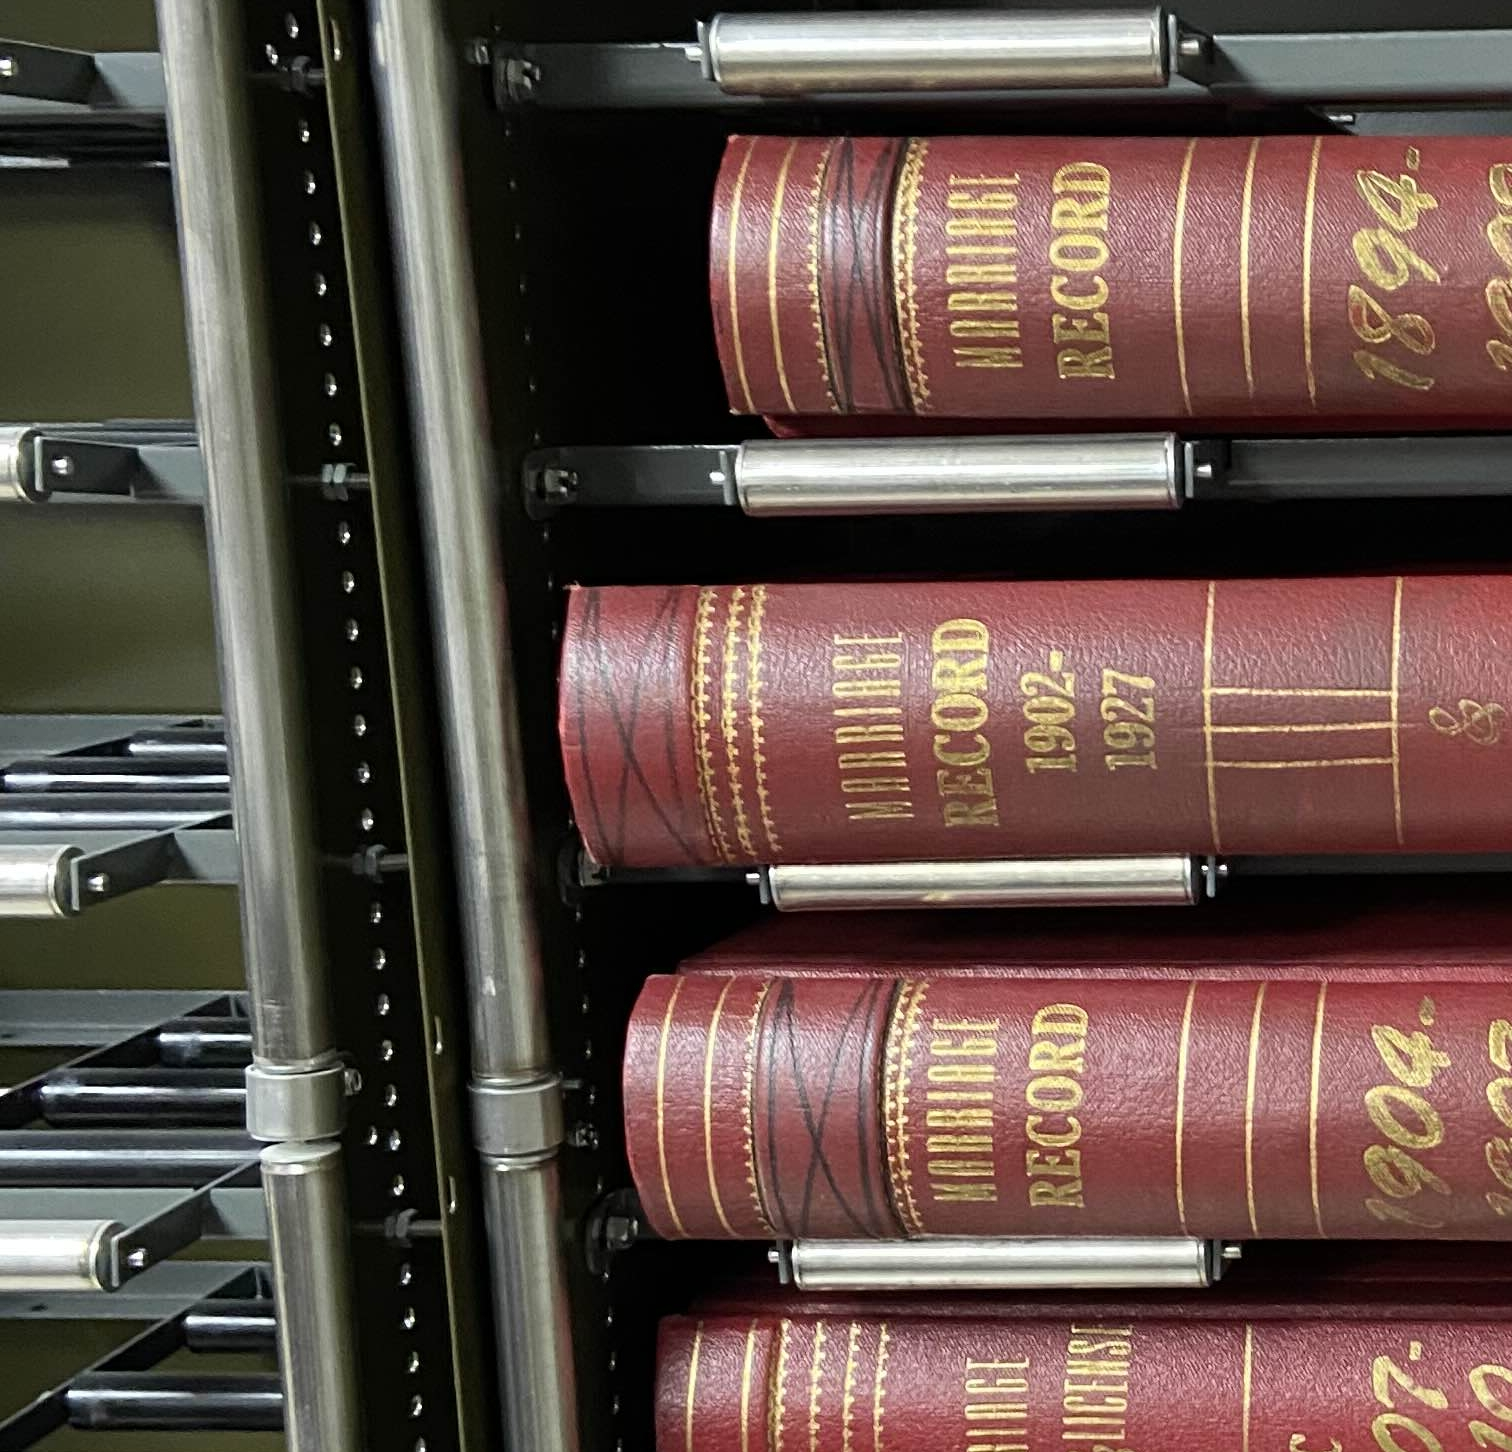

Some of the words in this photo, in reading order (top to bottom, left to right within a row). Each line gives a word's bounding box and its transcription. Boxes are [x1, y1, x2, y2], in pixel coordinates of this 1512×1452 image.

[946, 171, 1022, 369] MARRIAGE
[1049, 161, 1114, 379] RECORD
[1347, 147, 1441, 392] 1894-
[833, 631, 917, 821] MARRIAGE
[931, 617, 999, 828] RECORD
[1020, 651, 1079, 774] 1902-
[1100, 669, 1158, 772] 1927
[924, 1017, 1002, 1203] MARRIAGE
[1029, 1002, 1090, 1210] RECORD
[1062, 1323, 1134, 1441] LICENSE
